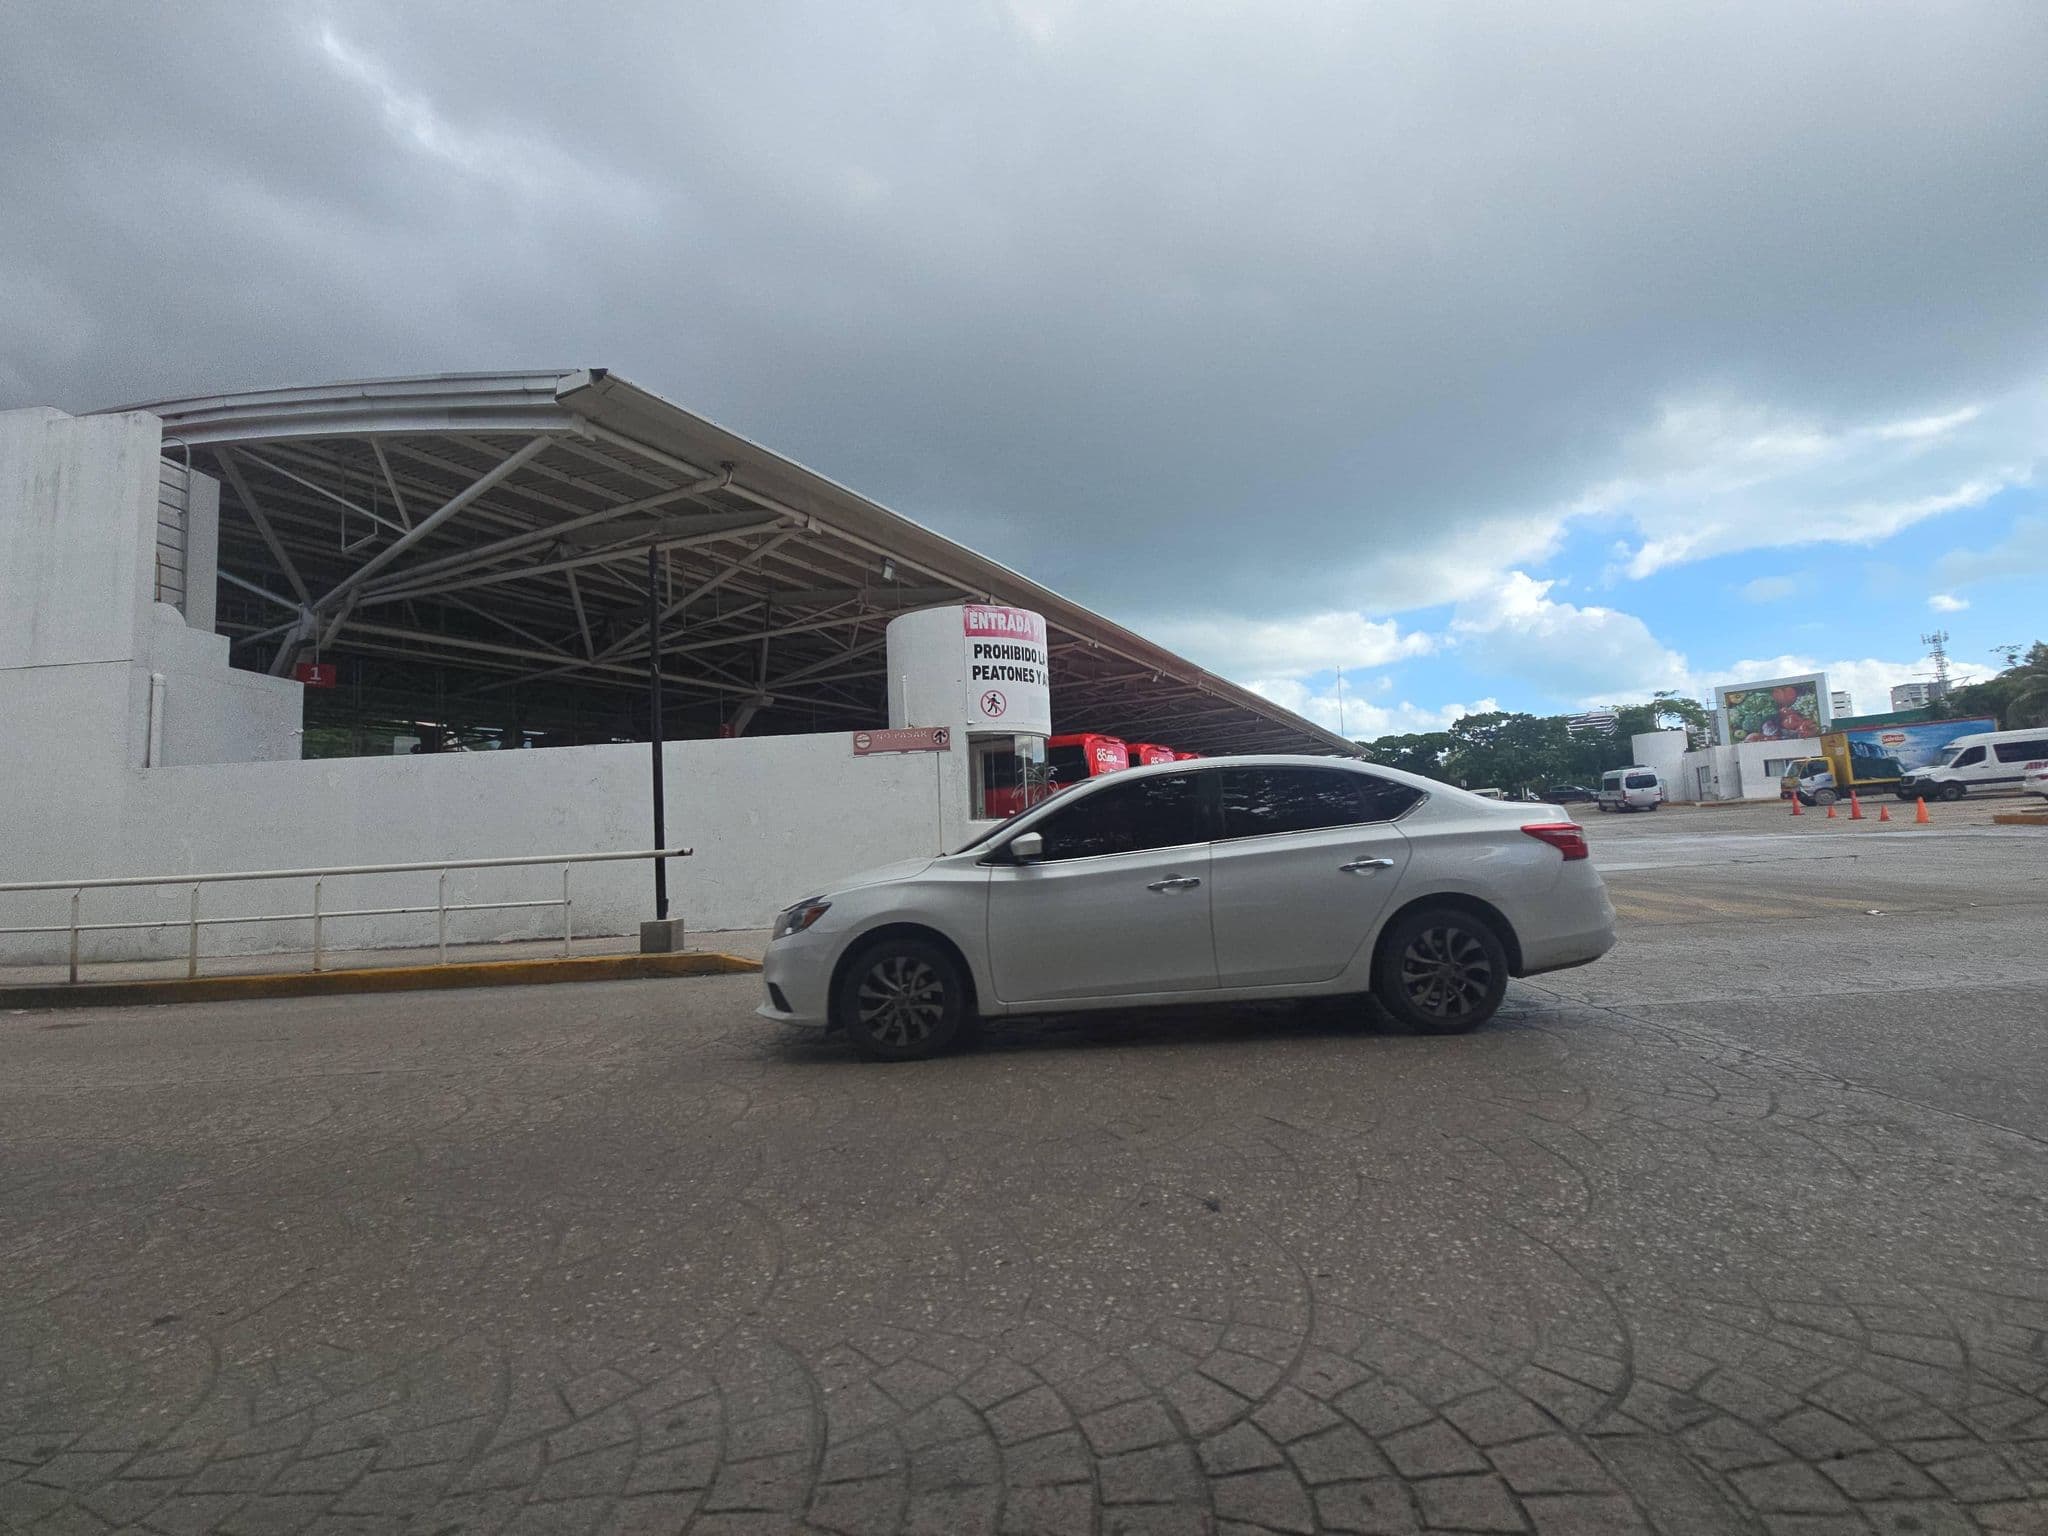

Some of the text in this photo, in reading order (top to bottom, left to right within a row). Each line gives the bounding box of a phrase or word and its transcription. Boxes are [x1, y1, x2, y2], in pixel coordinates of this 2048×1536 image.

[969, 611, 1031, 635] ENTRADA
[974, 644, 1036, 663] PROHIBIDO
[310, 666, 322, 680] 1
[972, 665, 1034, 683] PEATONES
[1036, 669, 1041, 685] Y
[1096, 748, 1107, 762] 85
